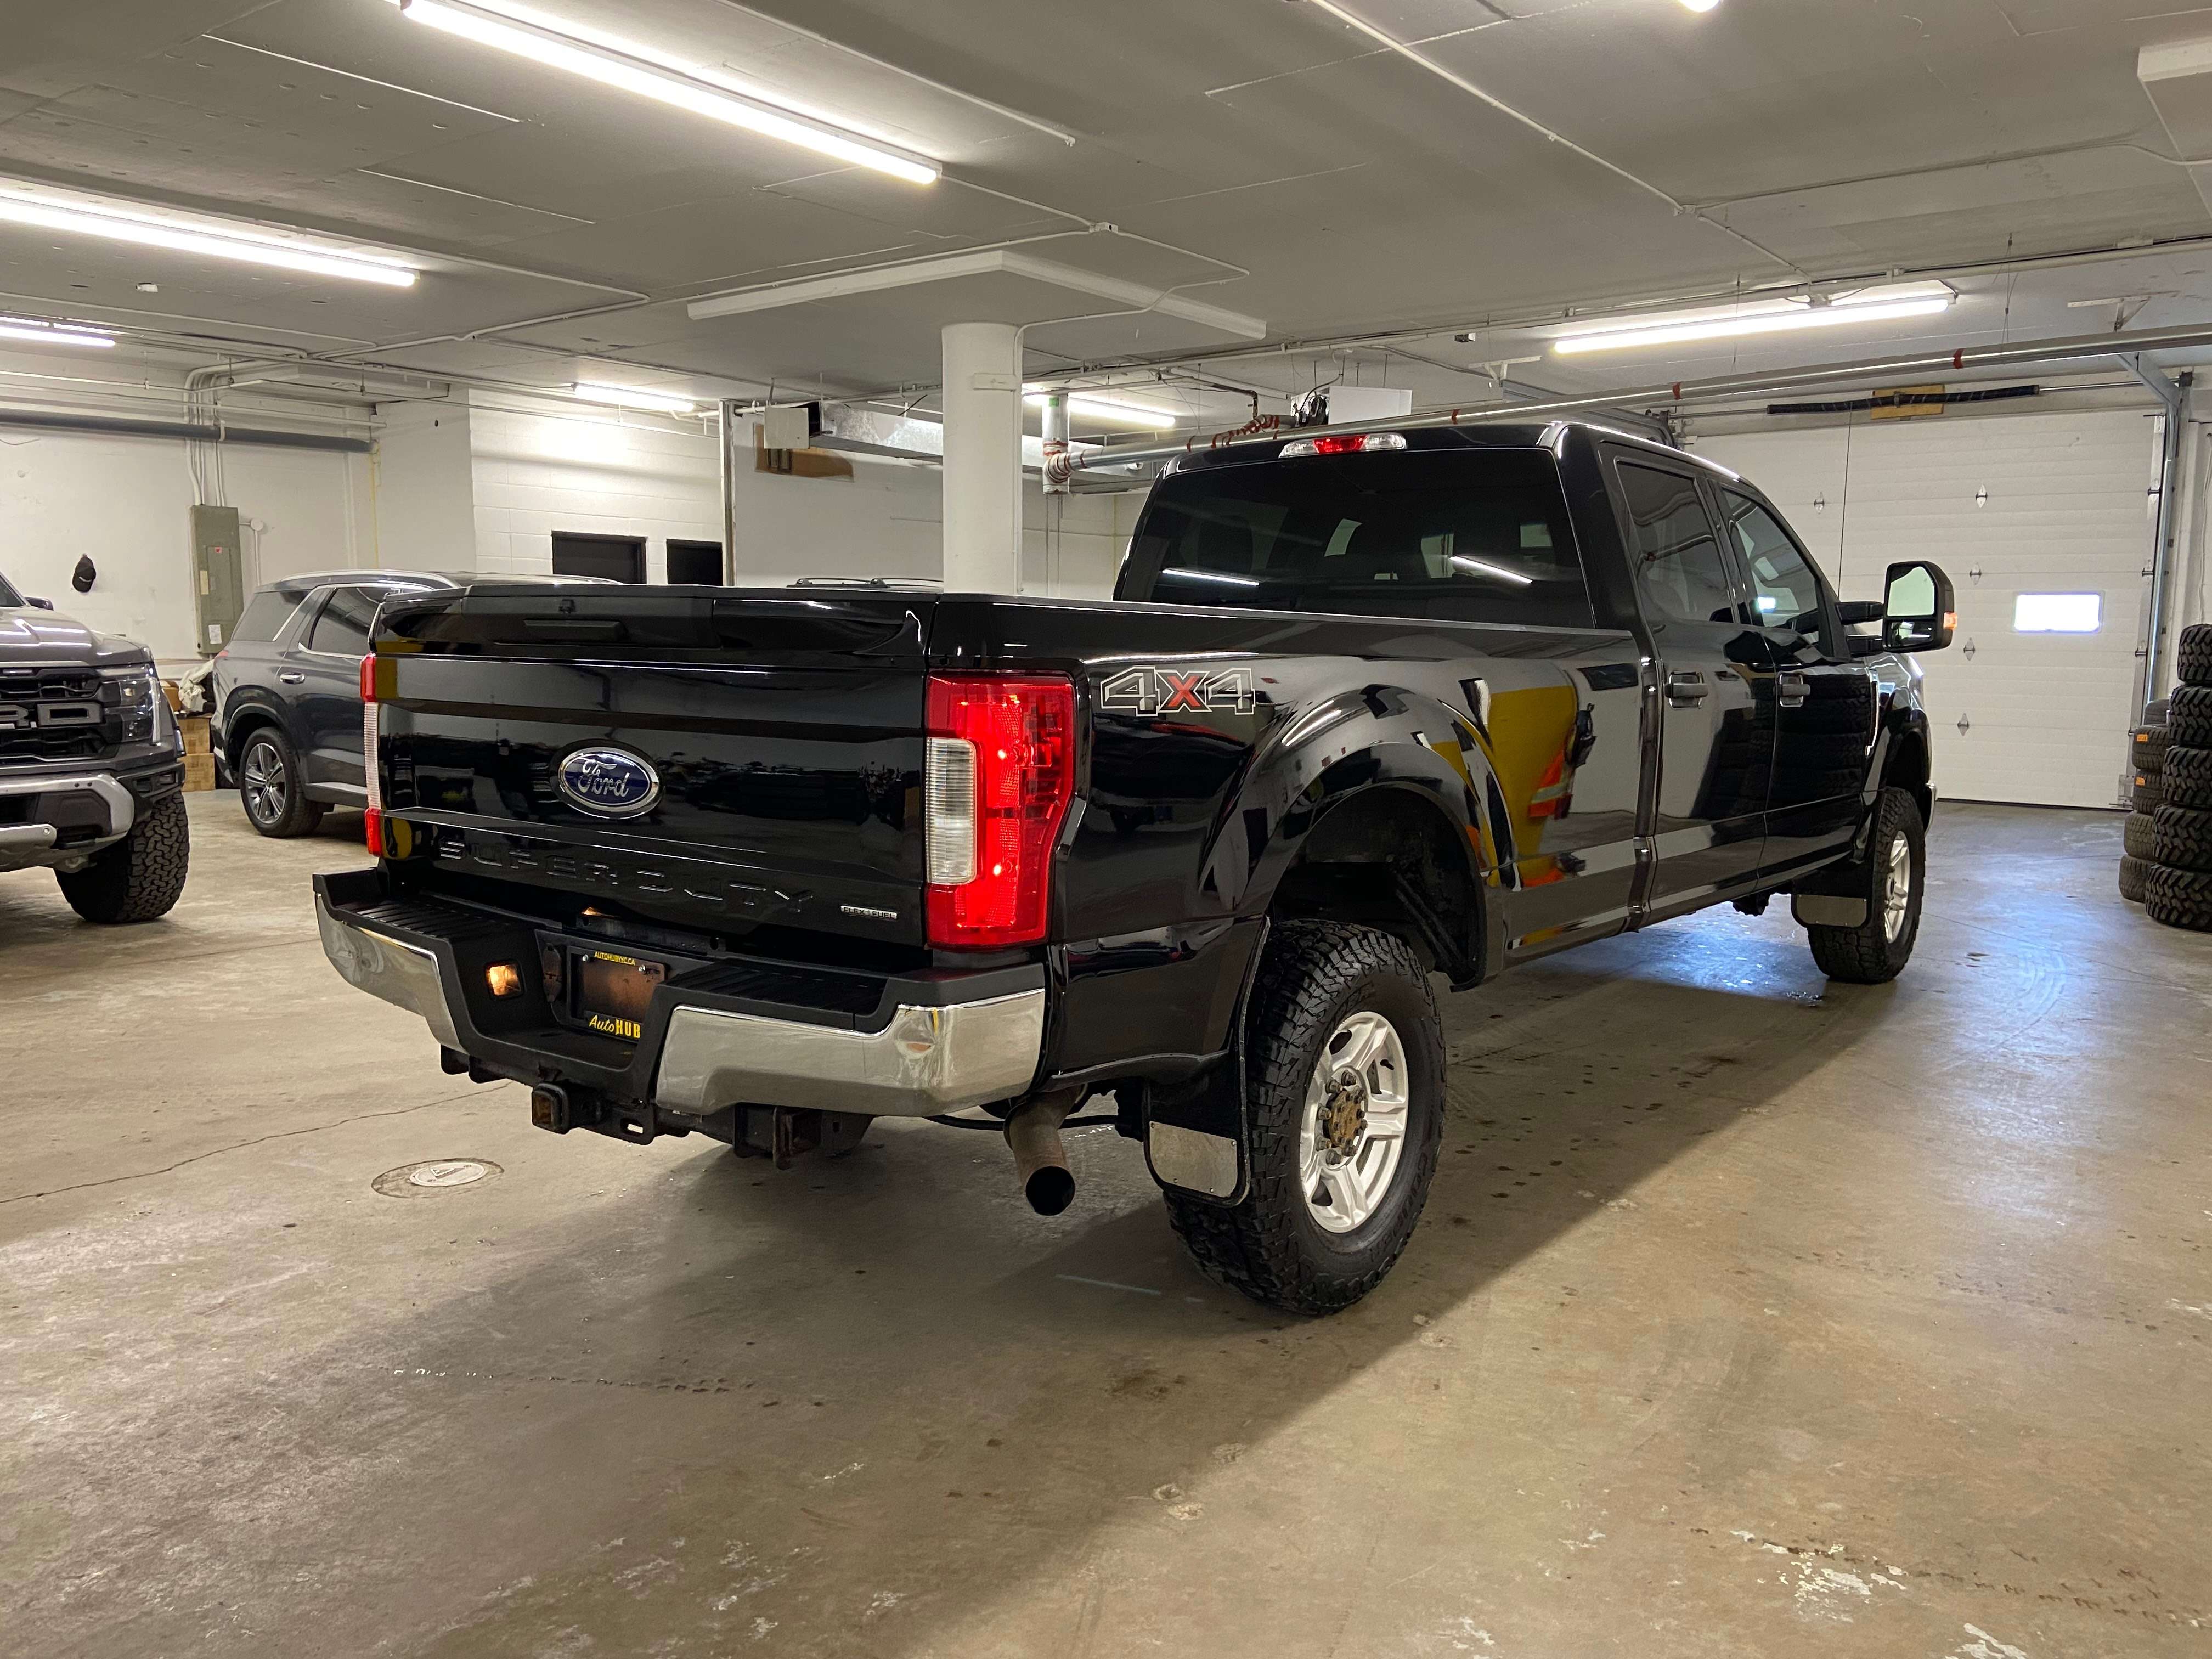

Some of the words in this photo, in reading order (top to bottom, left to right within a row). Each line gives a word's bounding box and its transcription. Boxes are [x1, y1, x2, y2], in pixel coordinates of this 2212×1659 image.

[577, 758, 630, 798] Ford
[843, 906, 865, 916] FLEX
[872, 910, 895, 919] FUEL
[589, 1015, 641, 1039] AutoHUB
